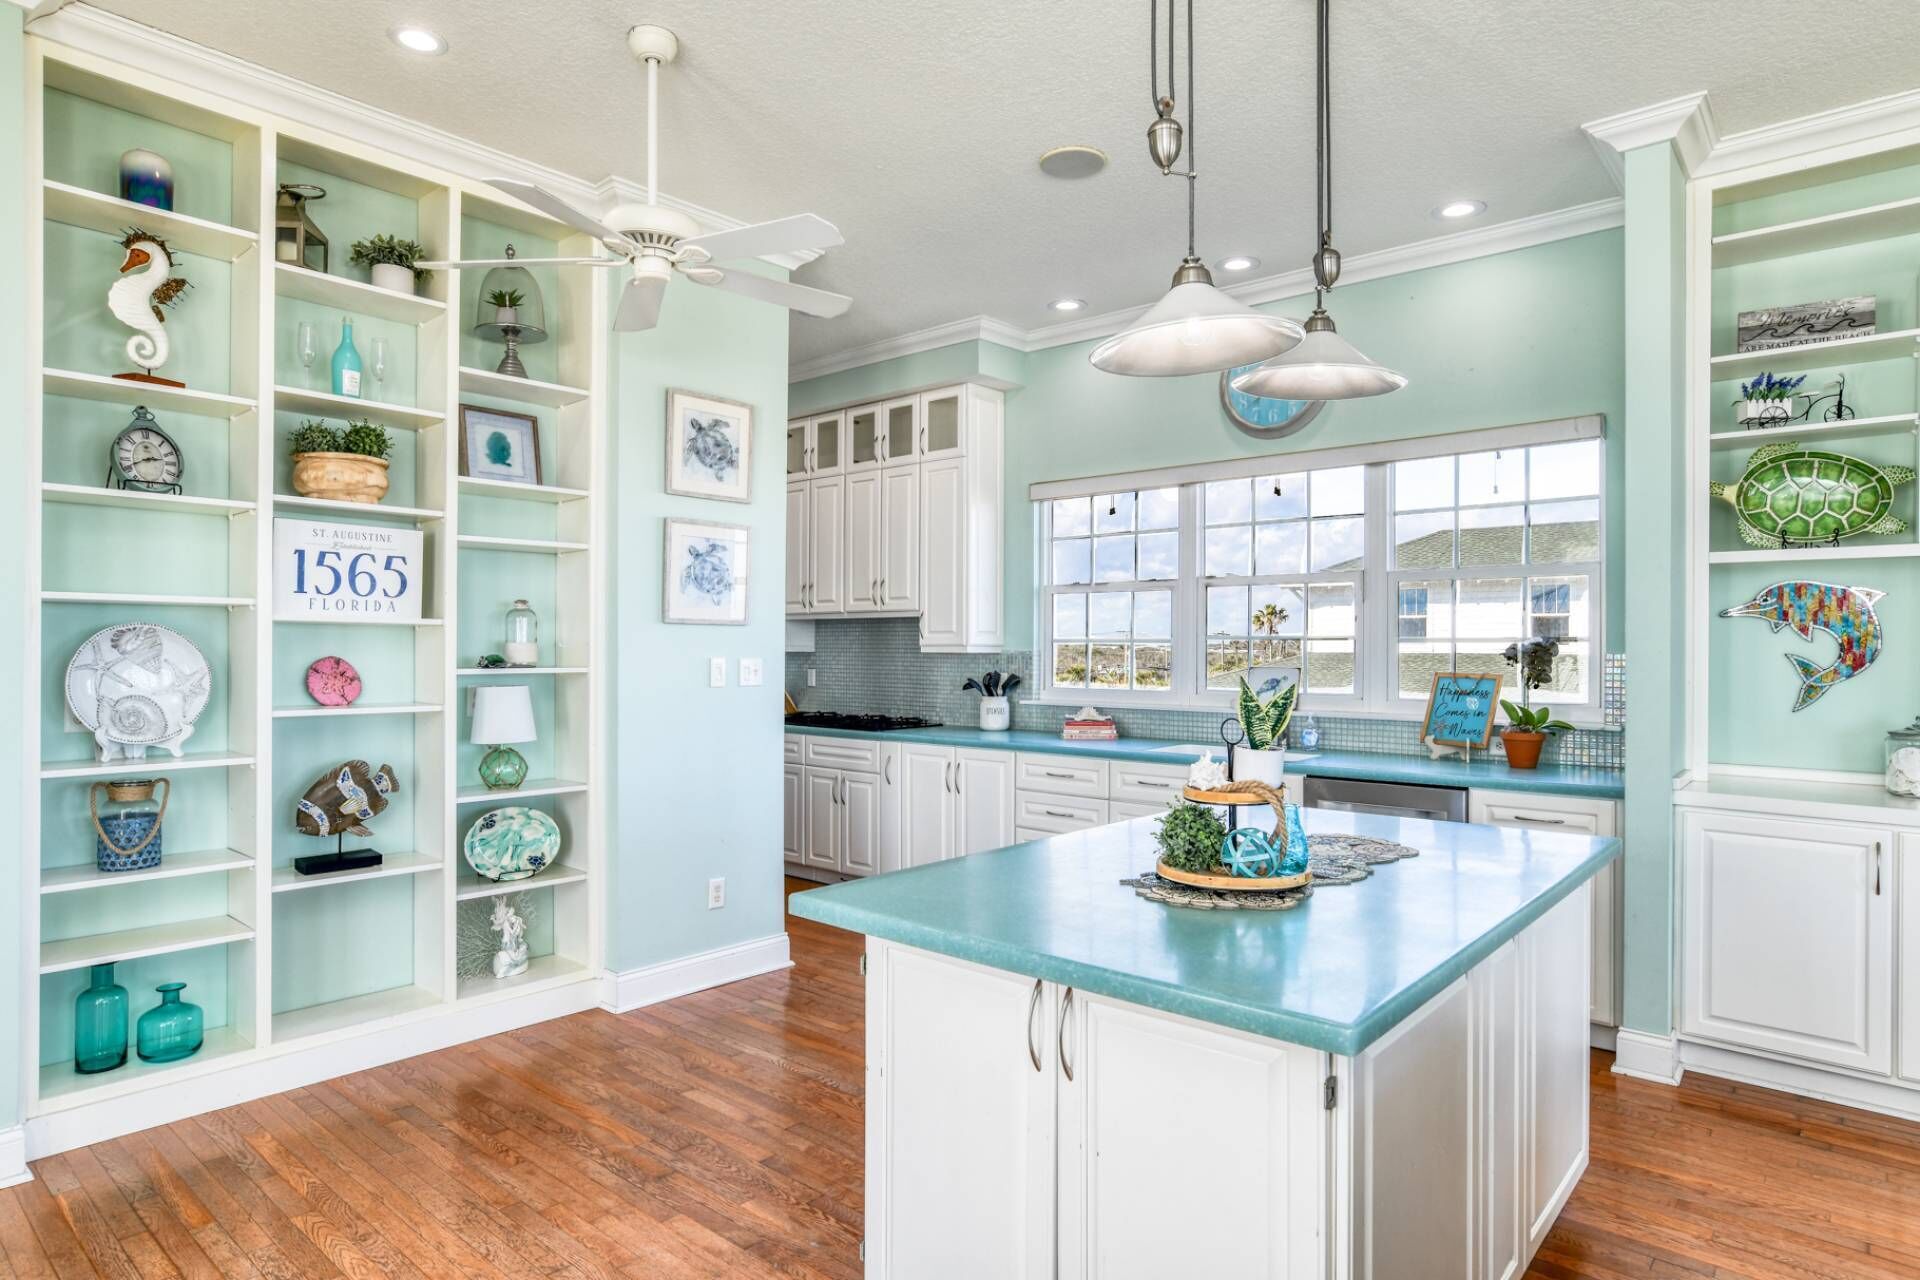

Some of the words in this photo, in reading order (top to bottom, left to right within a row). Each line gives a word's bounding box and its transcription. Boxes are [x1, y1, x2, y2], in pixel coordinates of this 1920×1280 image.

[312, 528, 329, 538] ST.
[332, 529, 393, 543] AUGUSTINE
[293, 549, 408, 598] 1565
[308, 597, 396, 612] FLORIDA
[1435, 702, 1469, 719] Comes
[1473, 709, 1486, 717] in
